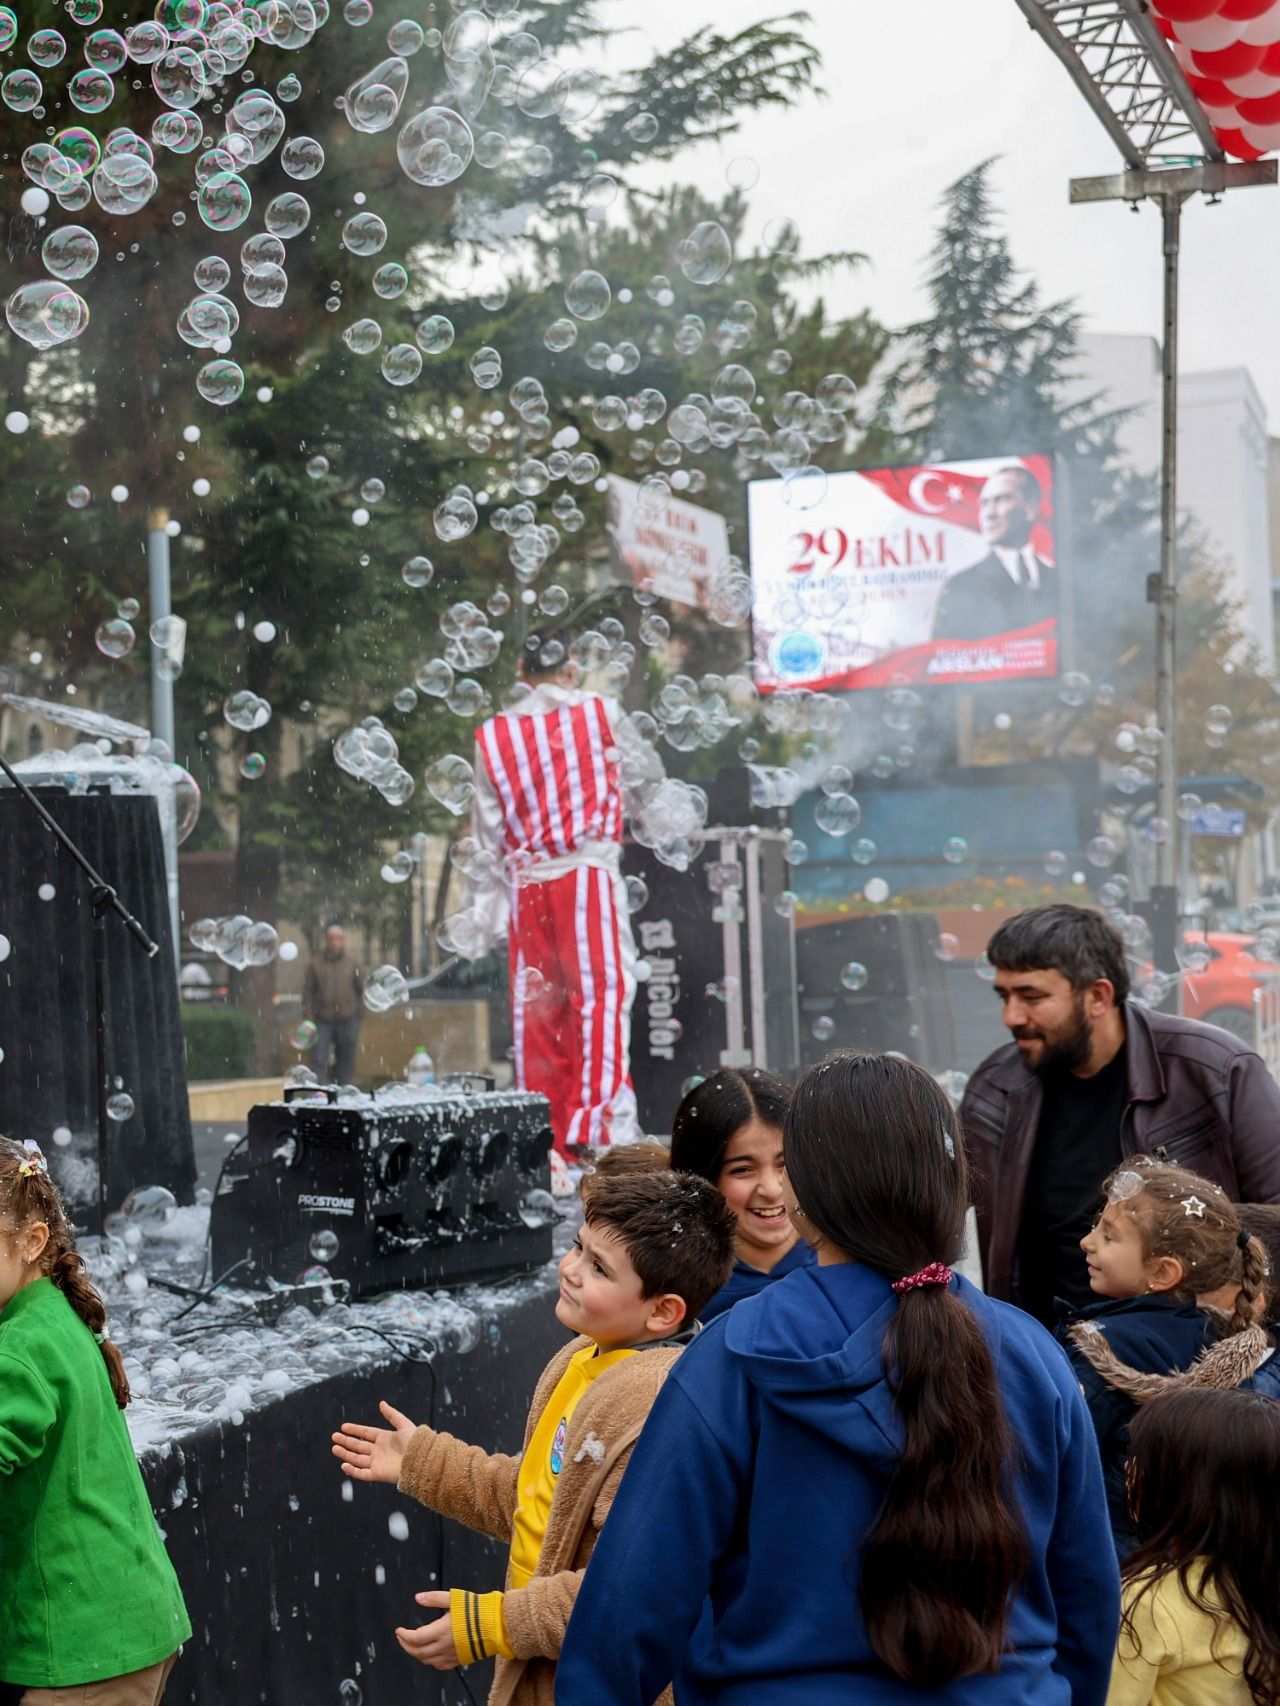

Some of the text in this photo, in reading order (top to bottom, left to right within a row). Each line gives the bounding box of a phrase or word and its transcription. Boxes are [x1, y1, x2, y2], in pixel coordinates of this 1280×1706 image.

[787, 527, 945, 574] 29 EKİM
[298, 1194, 356, 1209] PROSTONE
